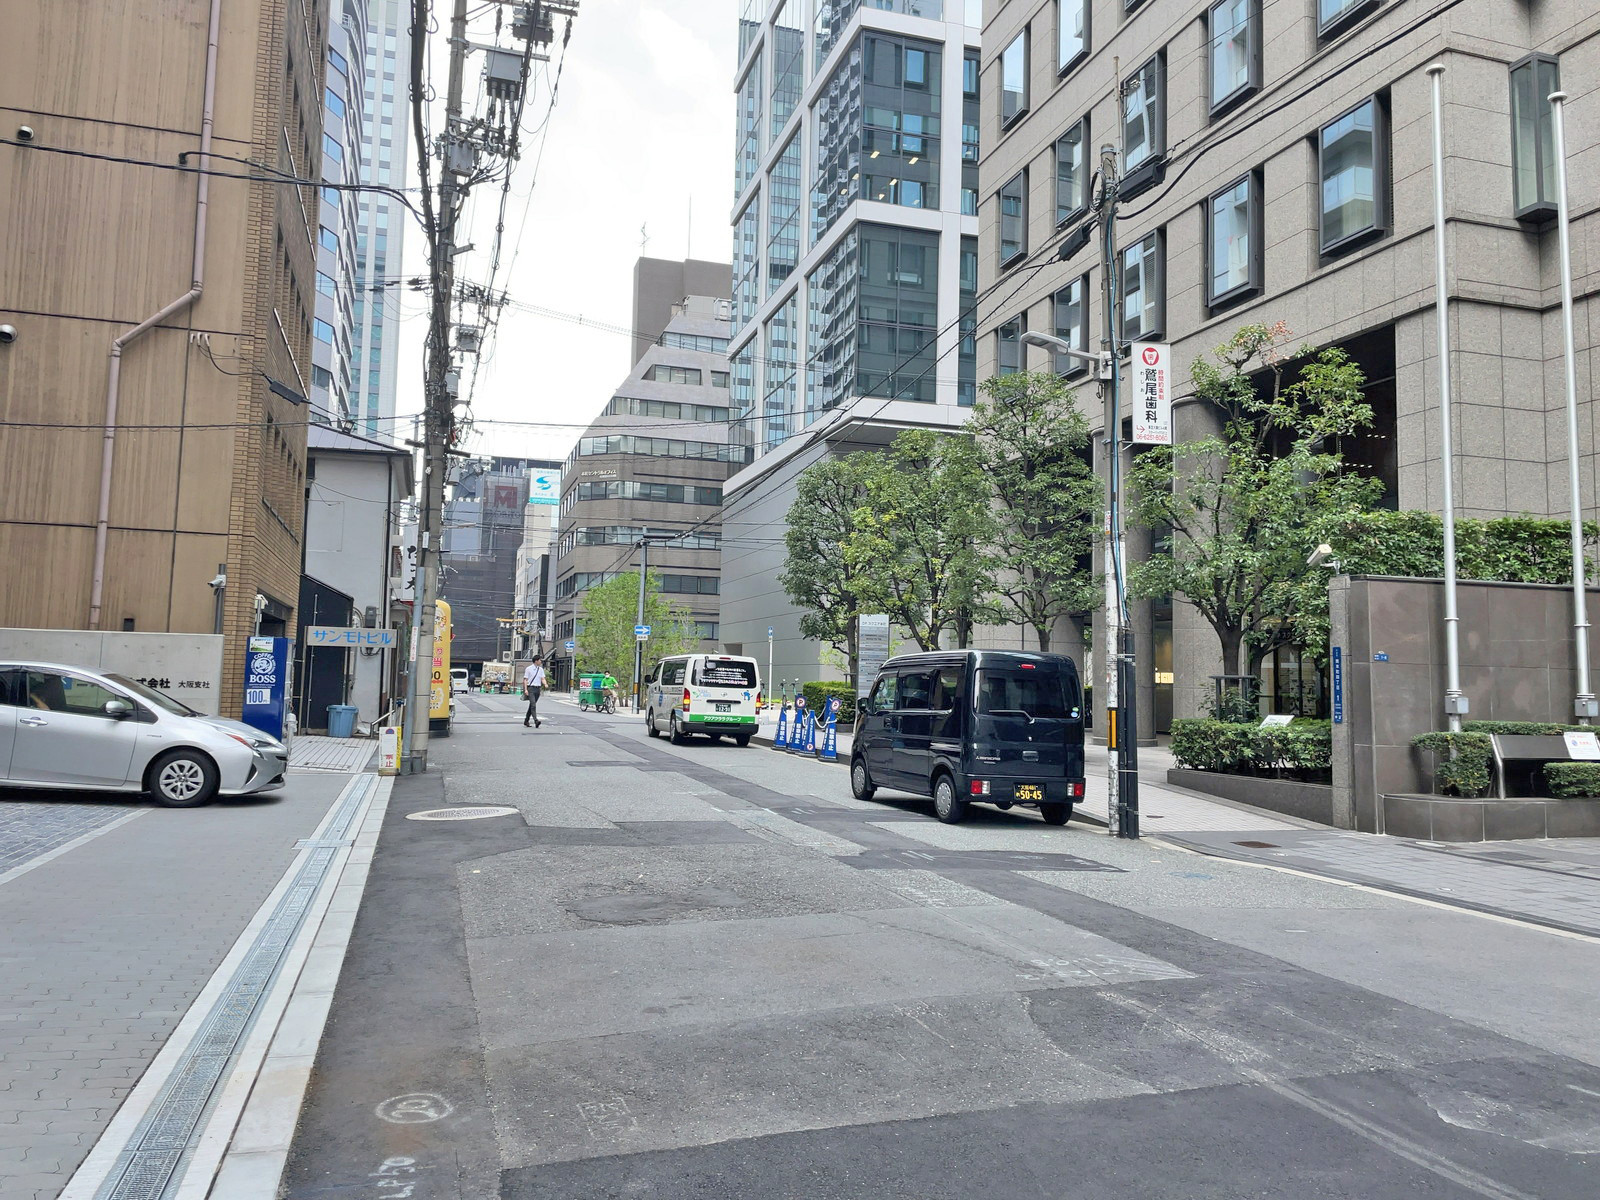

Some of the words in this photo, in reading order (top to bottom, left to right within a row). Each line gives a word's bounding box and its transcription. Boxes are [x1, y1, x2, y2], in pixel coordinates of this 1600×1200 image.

[313, 630, 393, 645] サンモトビル
[249, 674, 276, 683] BOSS
[248, 690, 264, 703] 100
[1020, 790, 1042, 800] 50-45
